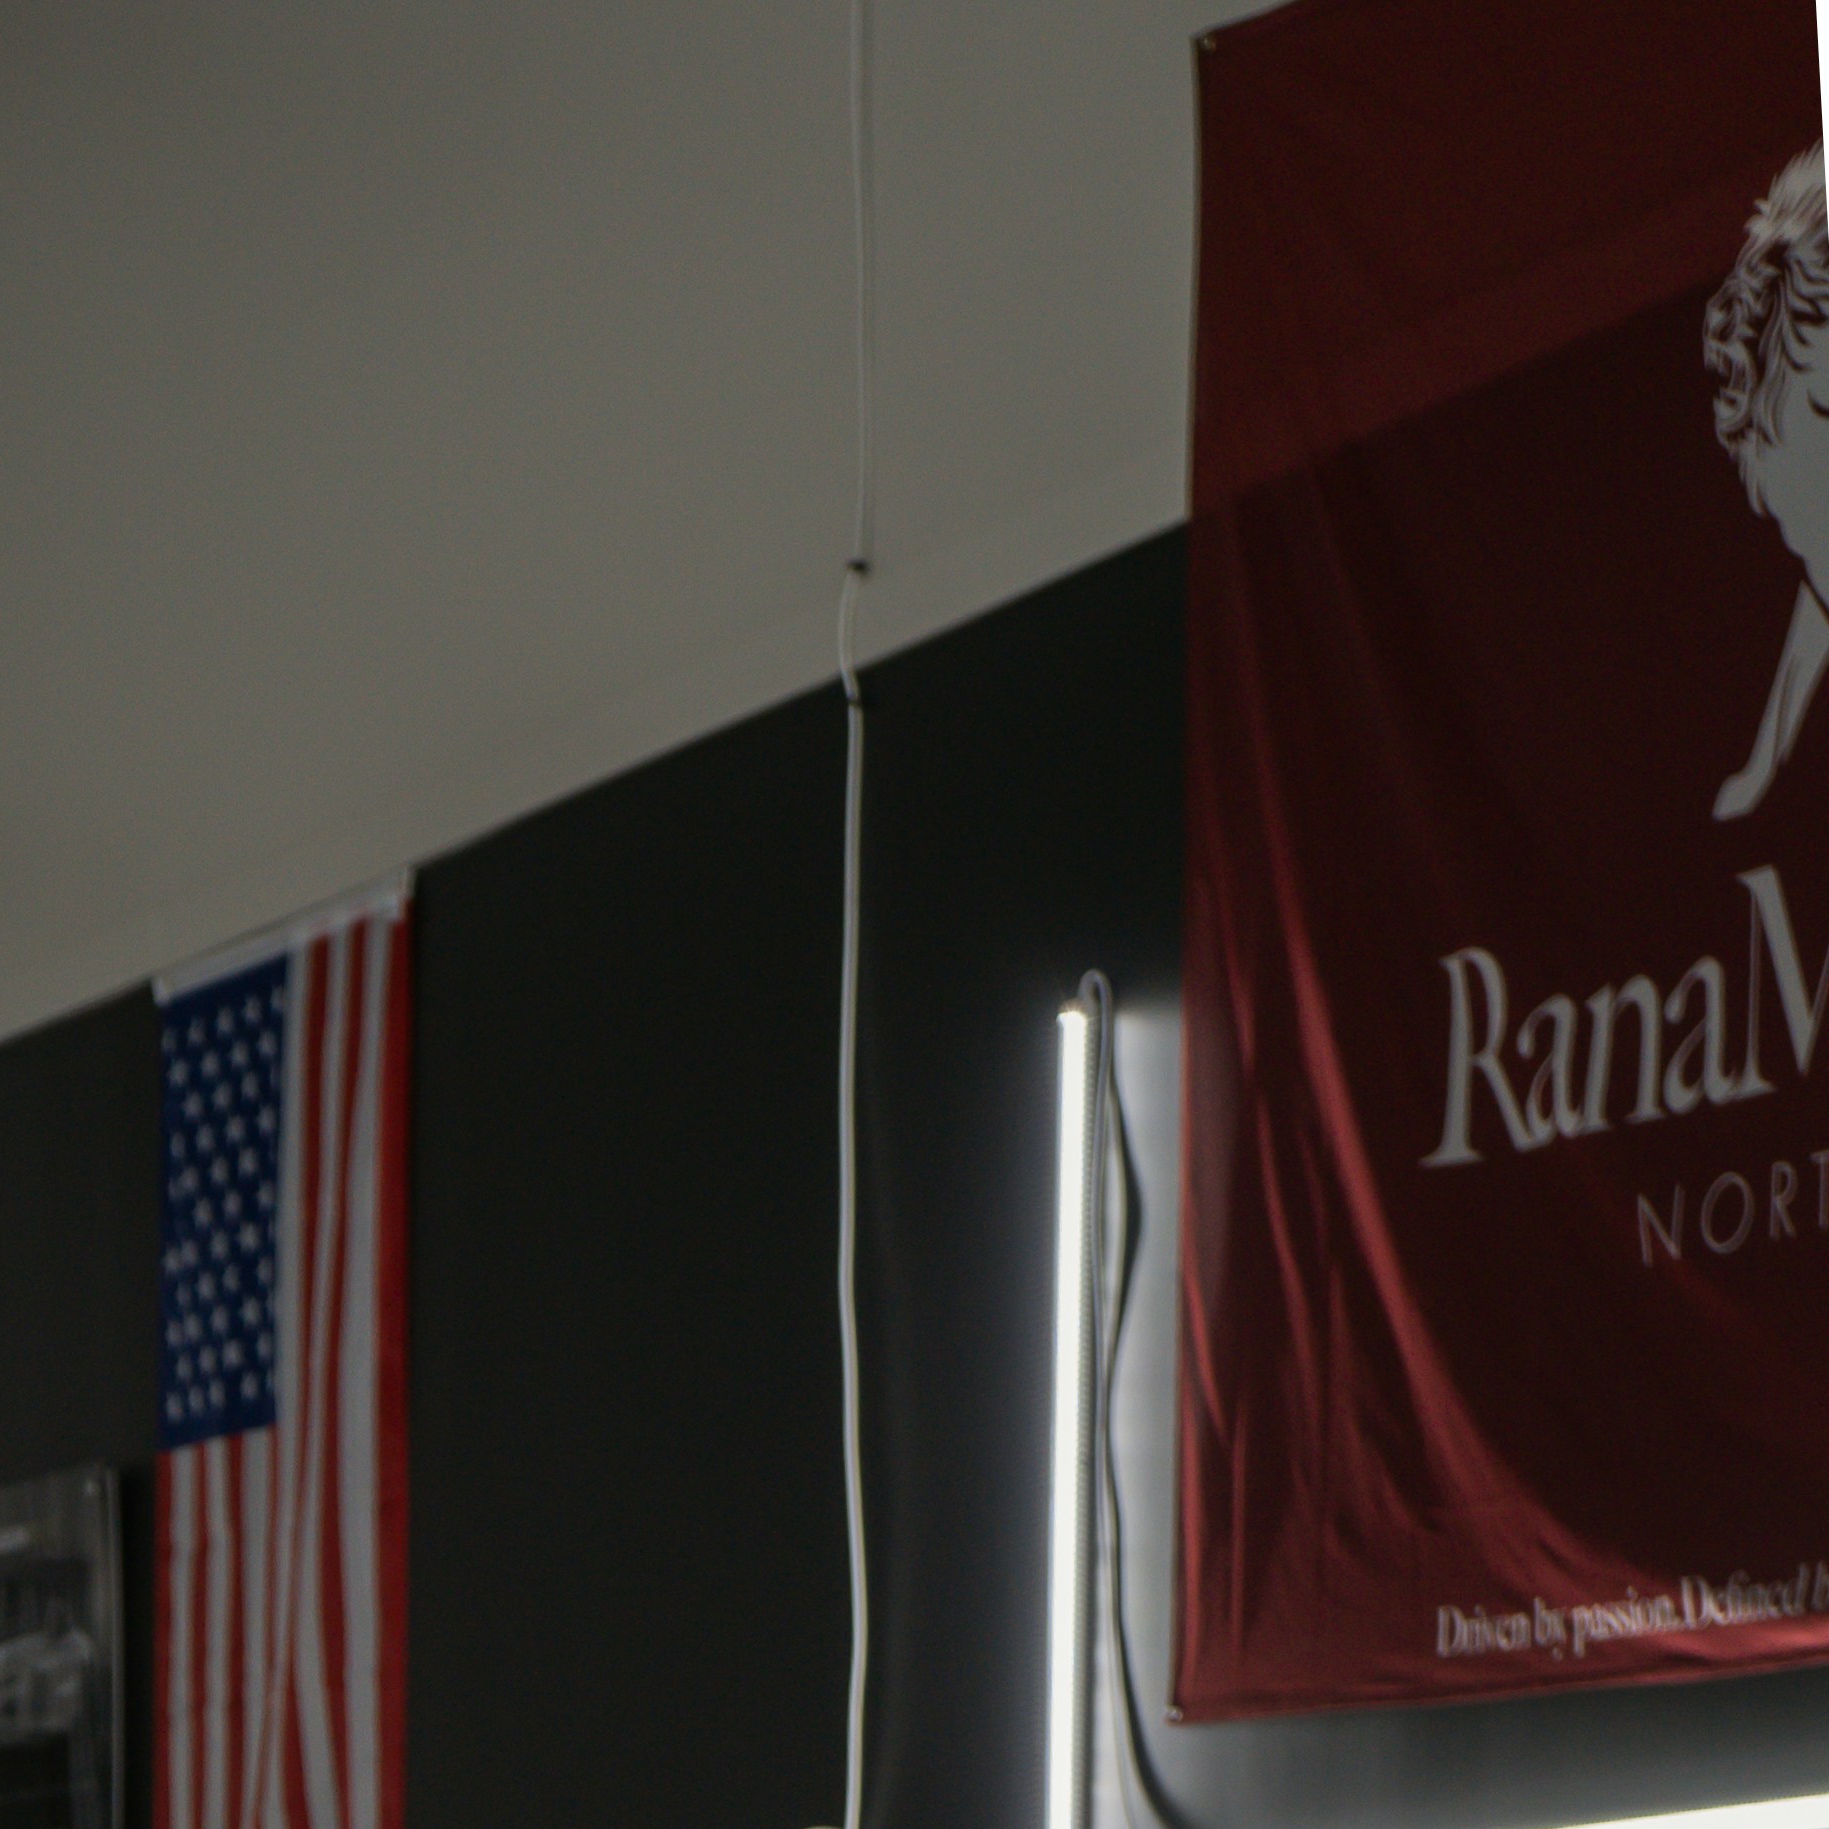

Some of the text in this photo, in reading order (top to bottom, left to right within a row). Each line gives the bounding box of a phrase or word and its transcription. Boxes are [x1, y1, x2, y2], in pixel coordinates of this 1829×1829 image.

[1436, 1604, 1532, 1658] Driven
[1533, 1596, 1567, 1661] by
[1681, 1560, 1811, 1630] Defined
